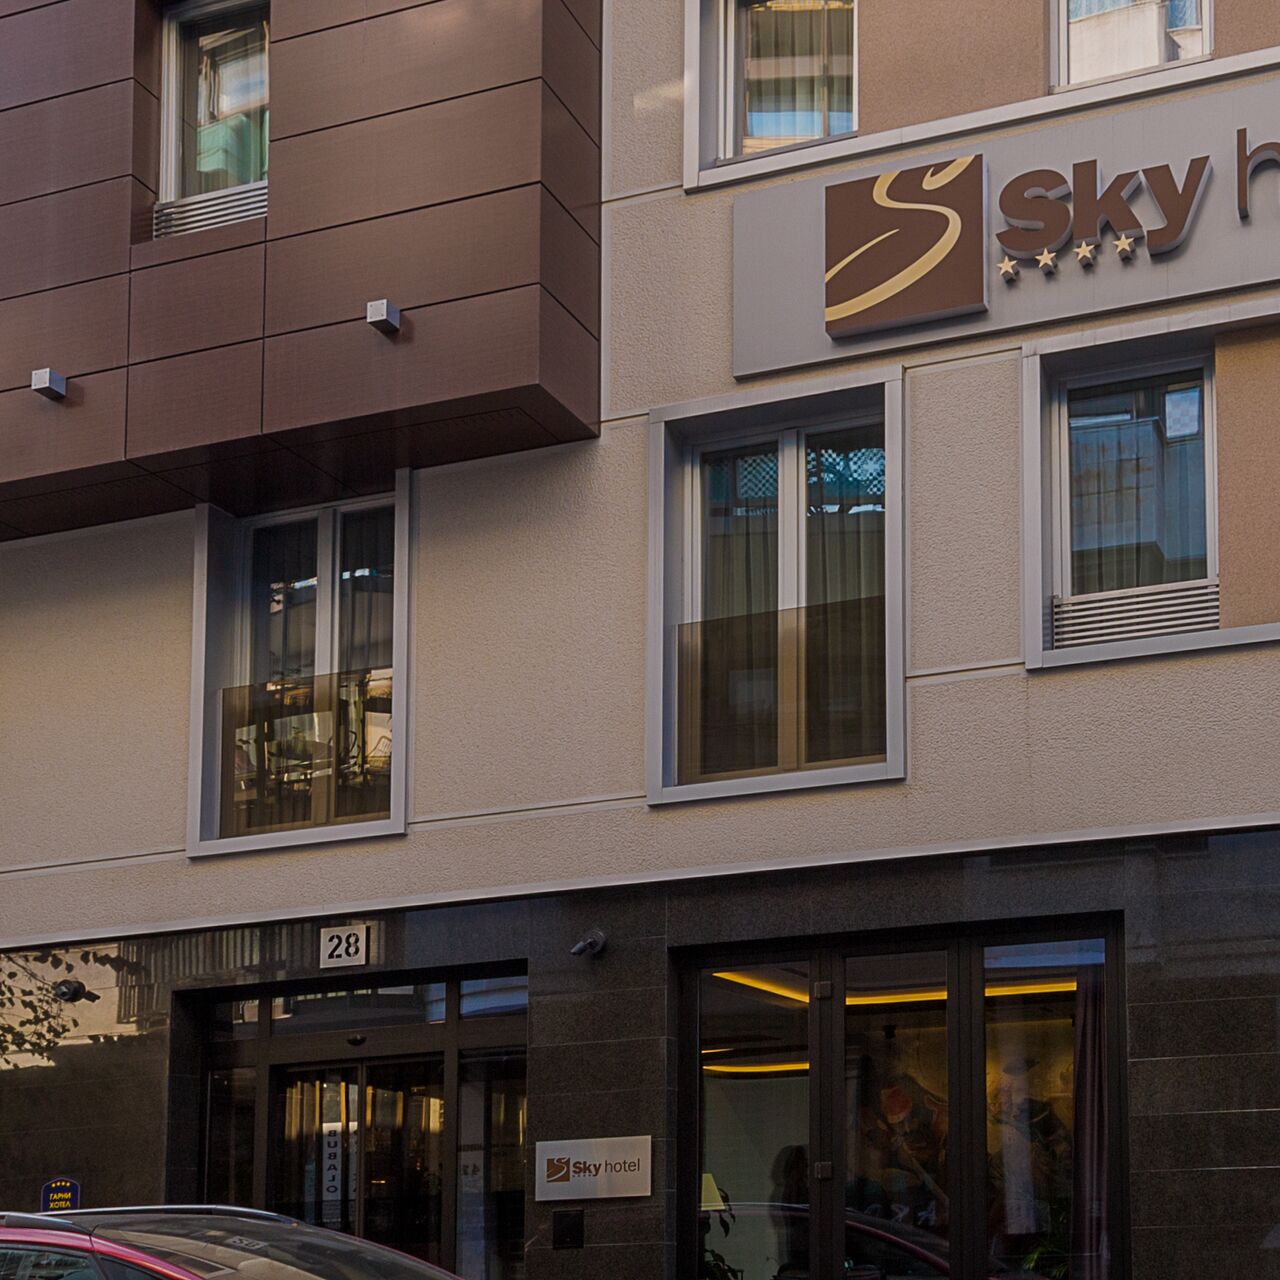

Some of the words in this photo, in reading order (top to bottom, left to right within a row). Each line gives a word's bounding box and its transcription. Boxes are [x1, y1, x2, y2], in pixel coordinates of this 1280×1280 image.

[327, 932, 360, 960] 28
[572, 1160, 602, 1177] Sky
[604, 1157, 641, 1174] hotel
